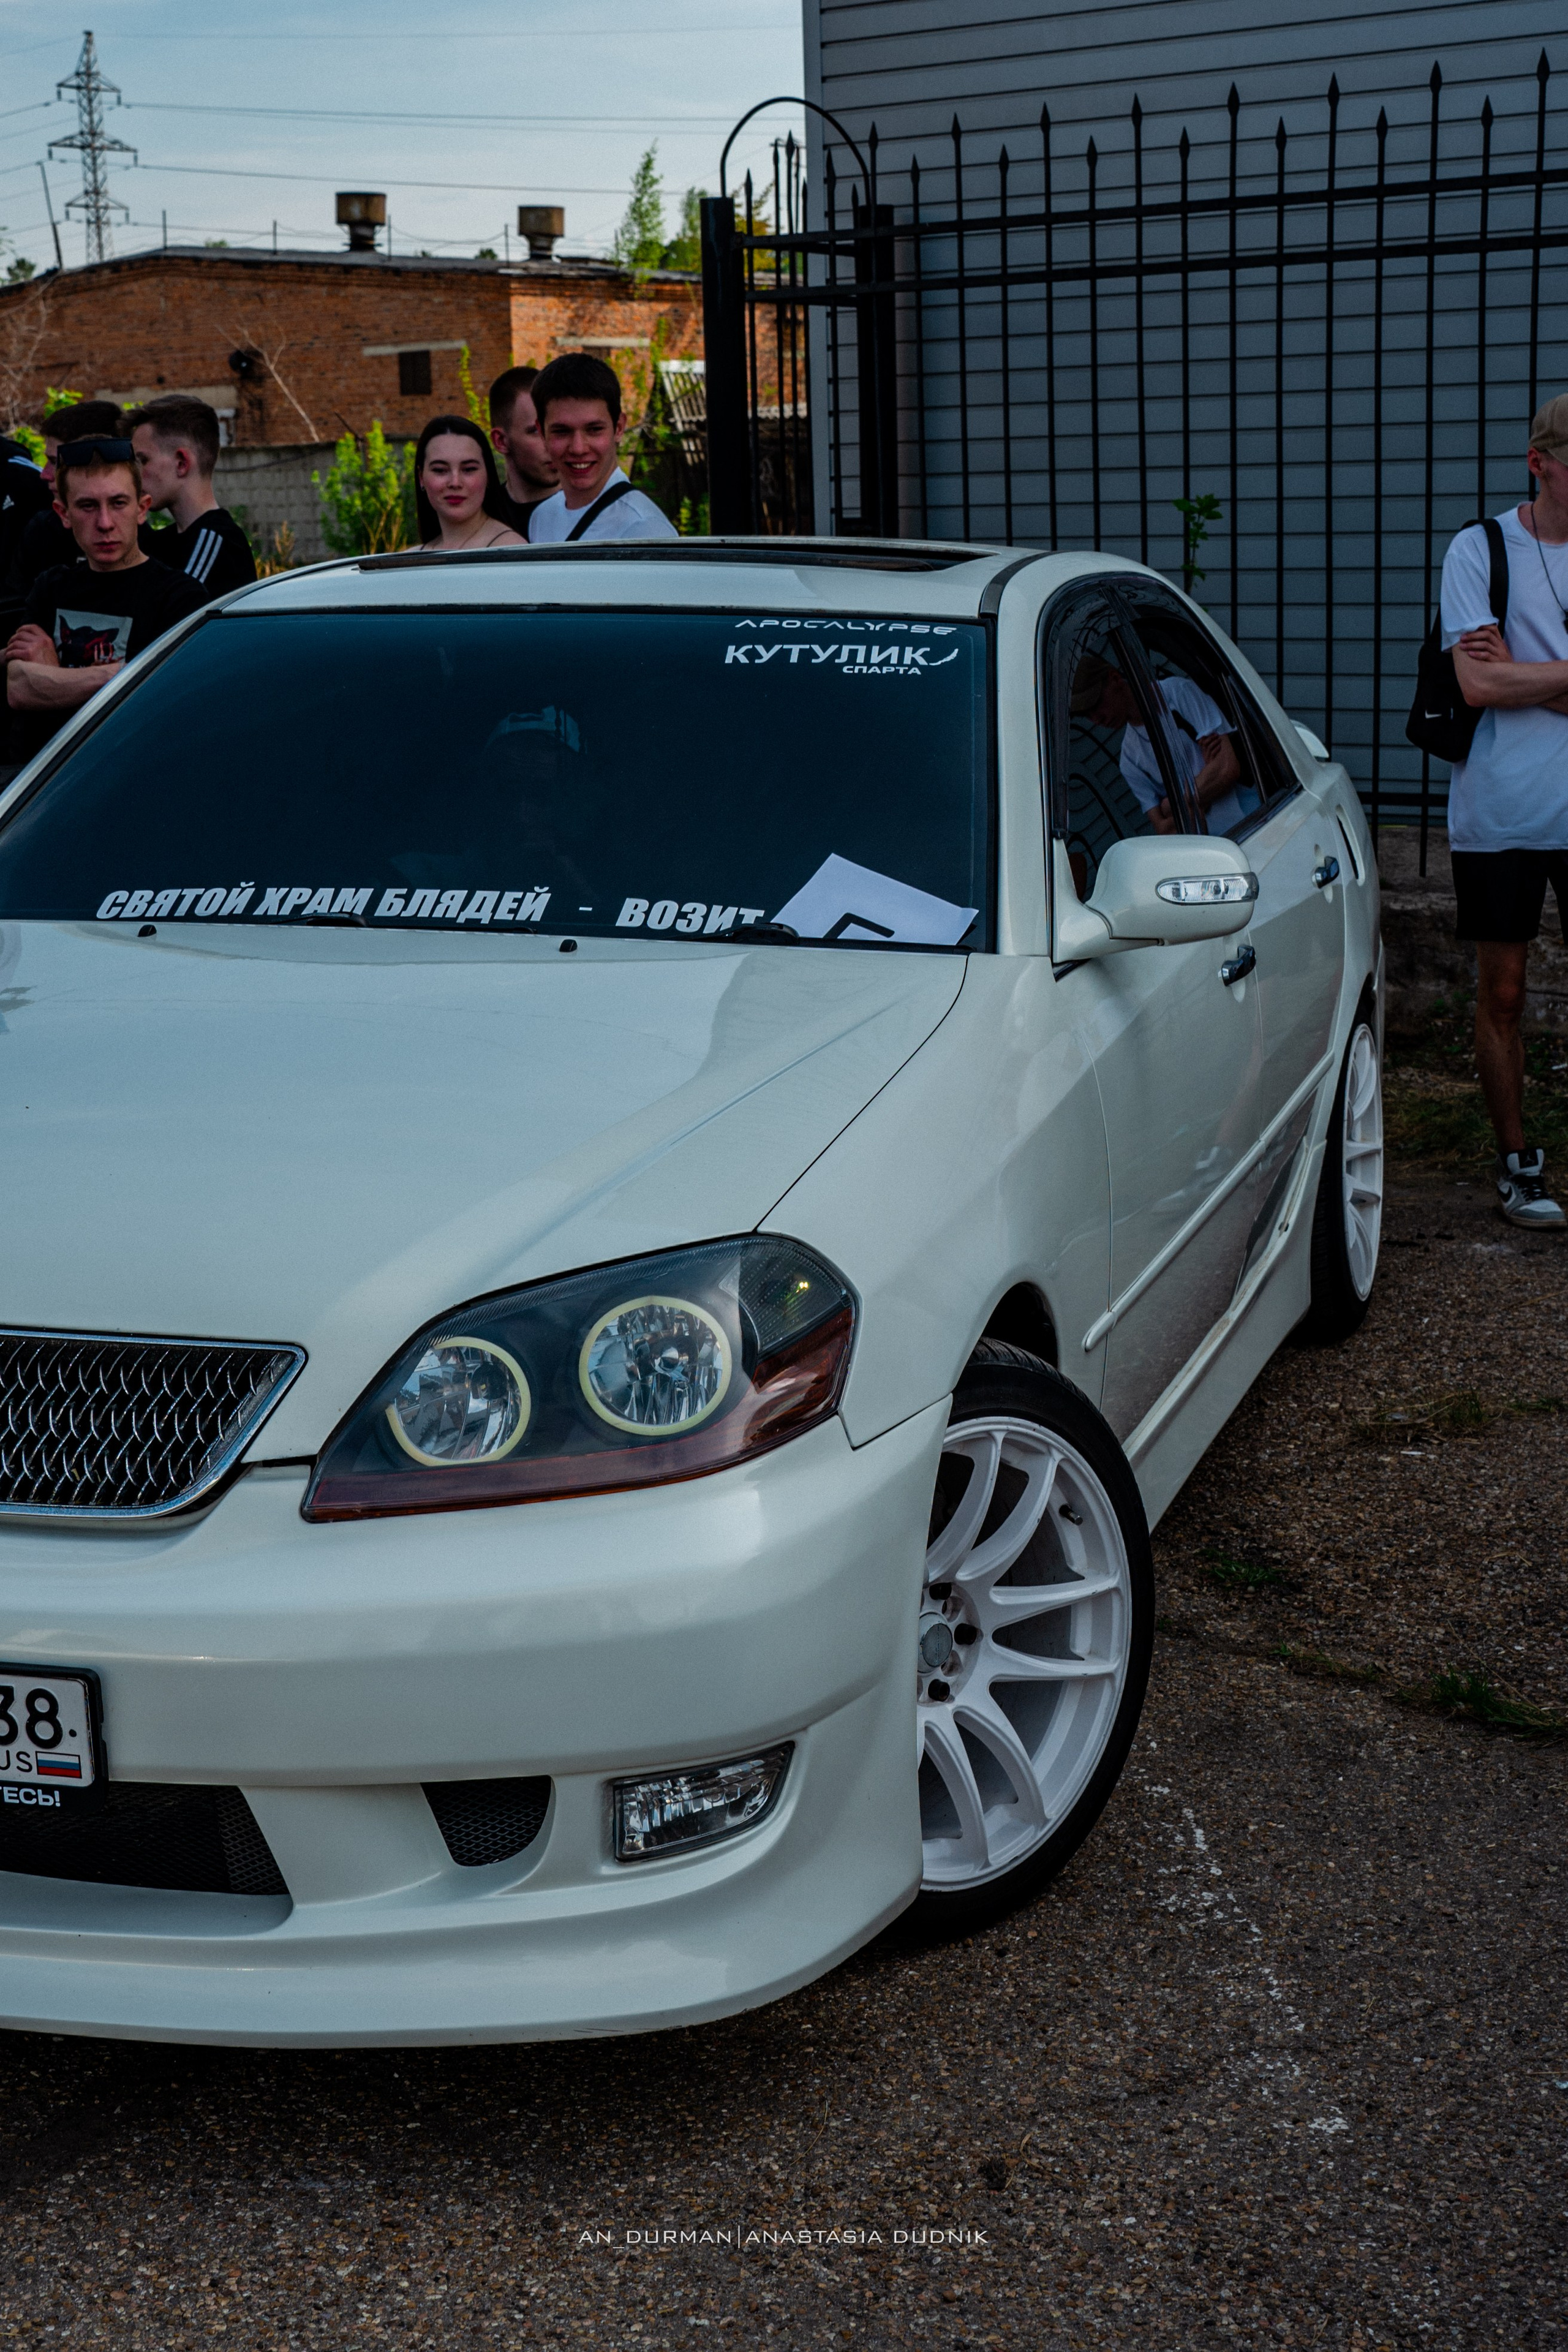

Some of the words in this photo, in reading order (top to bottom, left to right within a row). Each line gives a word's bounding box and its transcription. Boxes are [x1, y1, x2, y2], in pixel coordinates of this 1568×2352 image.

[735, 619, 957, 636] APOCALYPSE
[725, 644, 930, 666] КУТУЛИК
[842, 665, 921, 675] СПАРТА
[96, 881, 255, 919] СВЯТОЙ
[254, 888, 374, 915] ХРАМ
[374, 886, 552, 924] БЛЯДЕЙ
[615, 897, 765, 934] ВОЗИТ
[0, 1786, 61, 1807] ЕСЬ!
